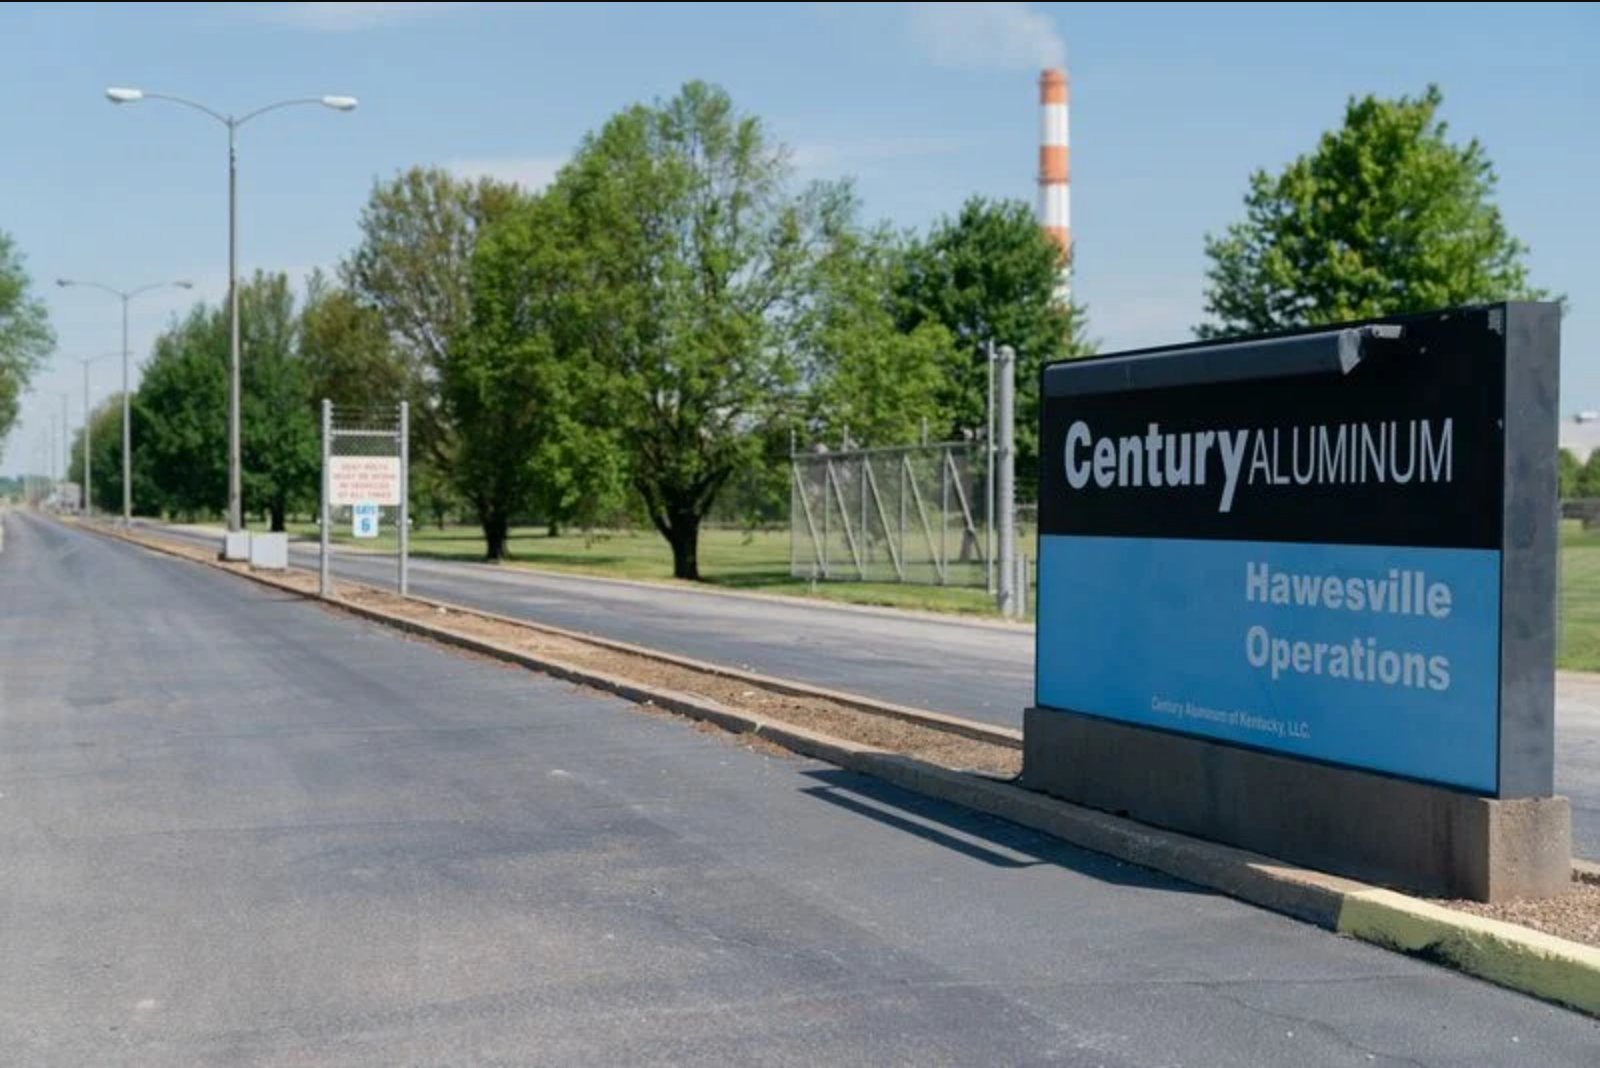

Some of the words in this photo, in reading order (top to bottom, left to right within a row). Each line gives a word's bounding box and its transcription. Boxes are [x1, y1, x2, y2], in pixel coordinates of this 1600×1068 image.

[361, 518, 371, 533] 6
[1246, 562, 1452, 619] Hawesville
[1246, 626, 1450, 691] Operations
[1151, 695, 1183, 719] Century
